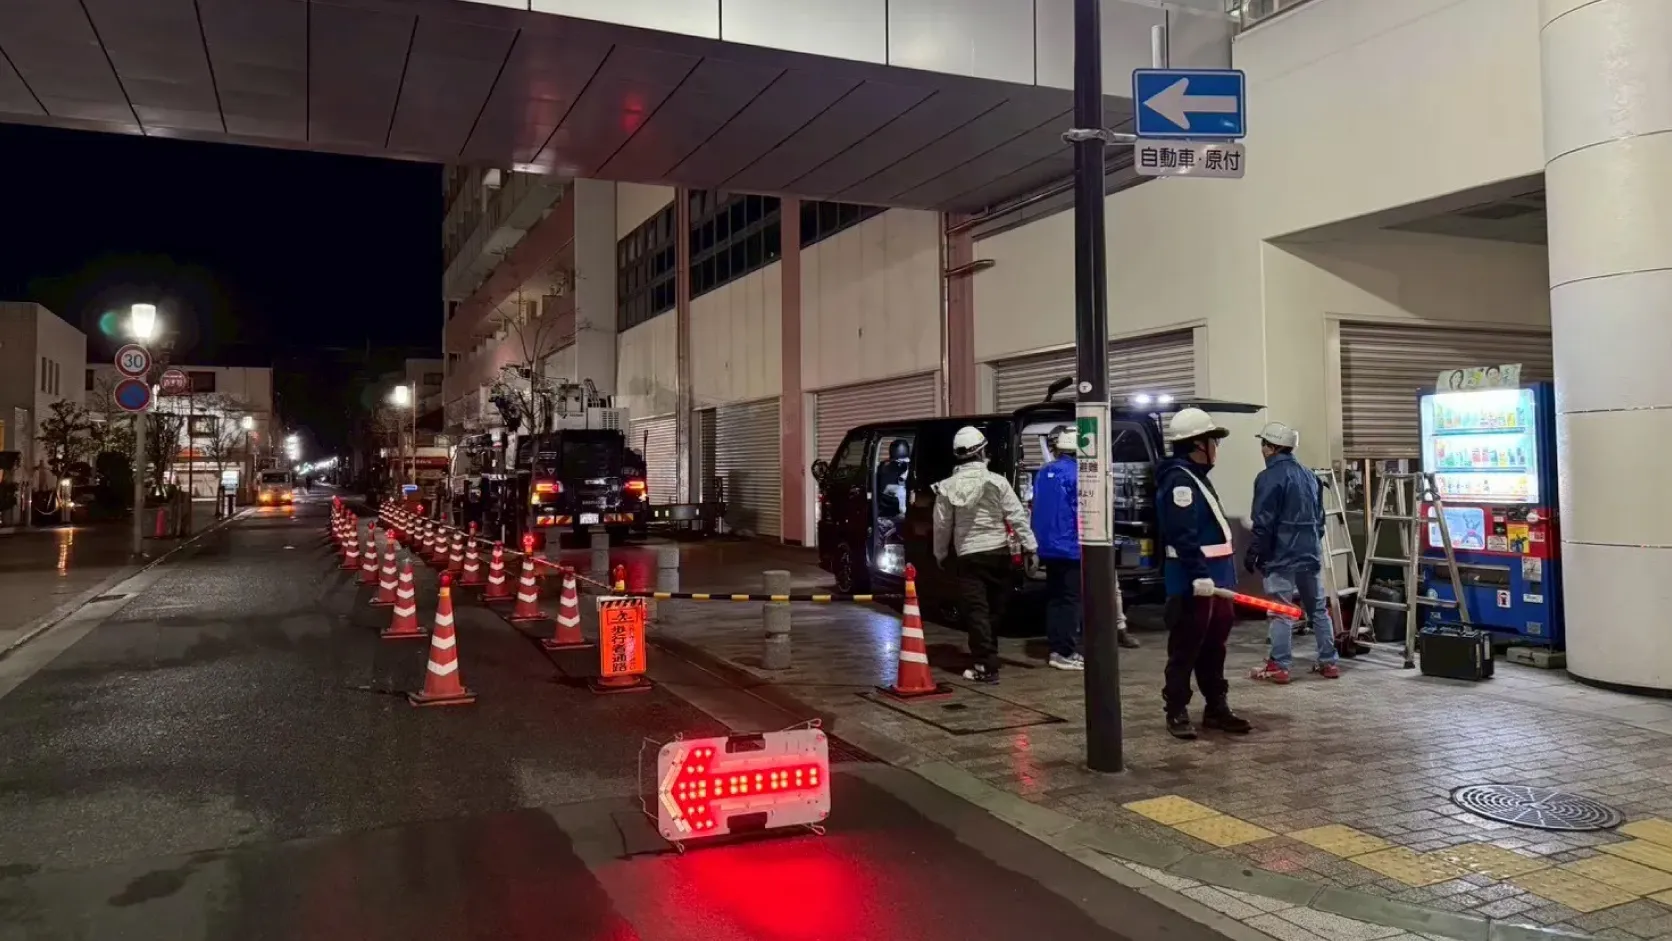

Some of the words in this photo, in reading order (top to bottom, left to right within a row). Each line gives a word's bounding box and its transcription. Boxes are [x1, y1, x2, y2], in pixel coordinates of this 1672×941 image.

[1140, 146, 1241, 171] 自動車・原付
[123, 353, 143, 368] 30
[611, 625, 627, 672] 歩行者通路
